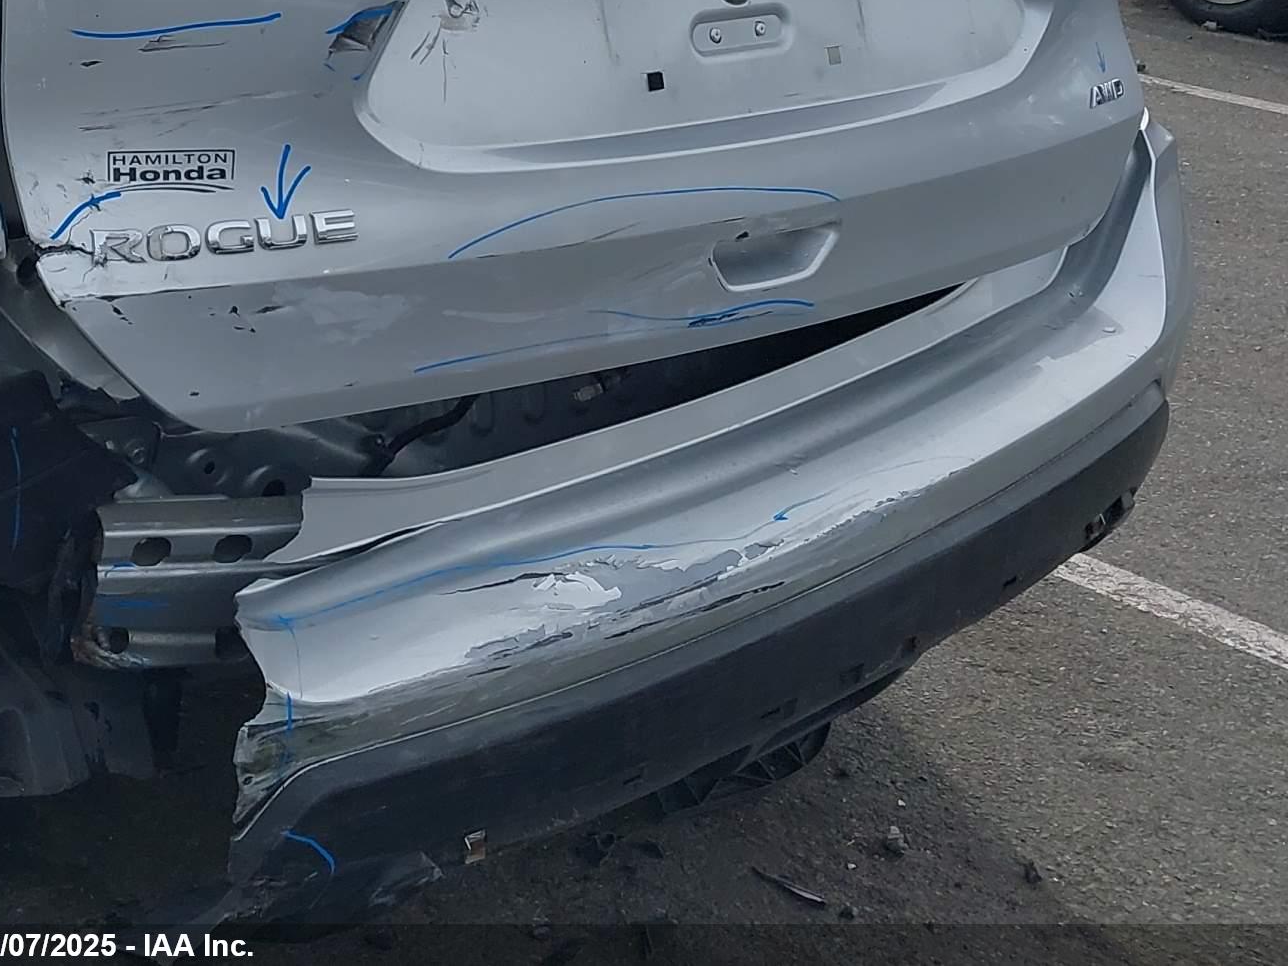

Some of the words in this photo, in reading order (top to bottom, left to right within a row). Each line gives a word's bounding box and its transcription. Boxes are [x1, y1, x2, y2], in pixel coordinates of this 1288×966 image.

[1089, 78, 1125, 109] AWD
[112, 152, 228, 166] HAMILTON
[112, 165, 227, 183] Honda
[89, 208, 359, 265] ROGUE
